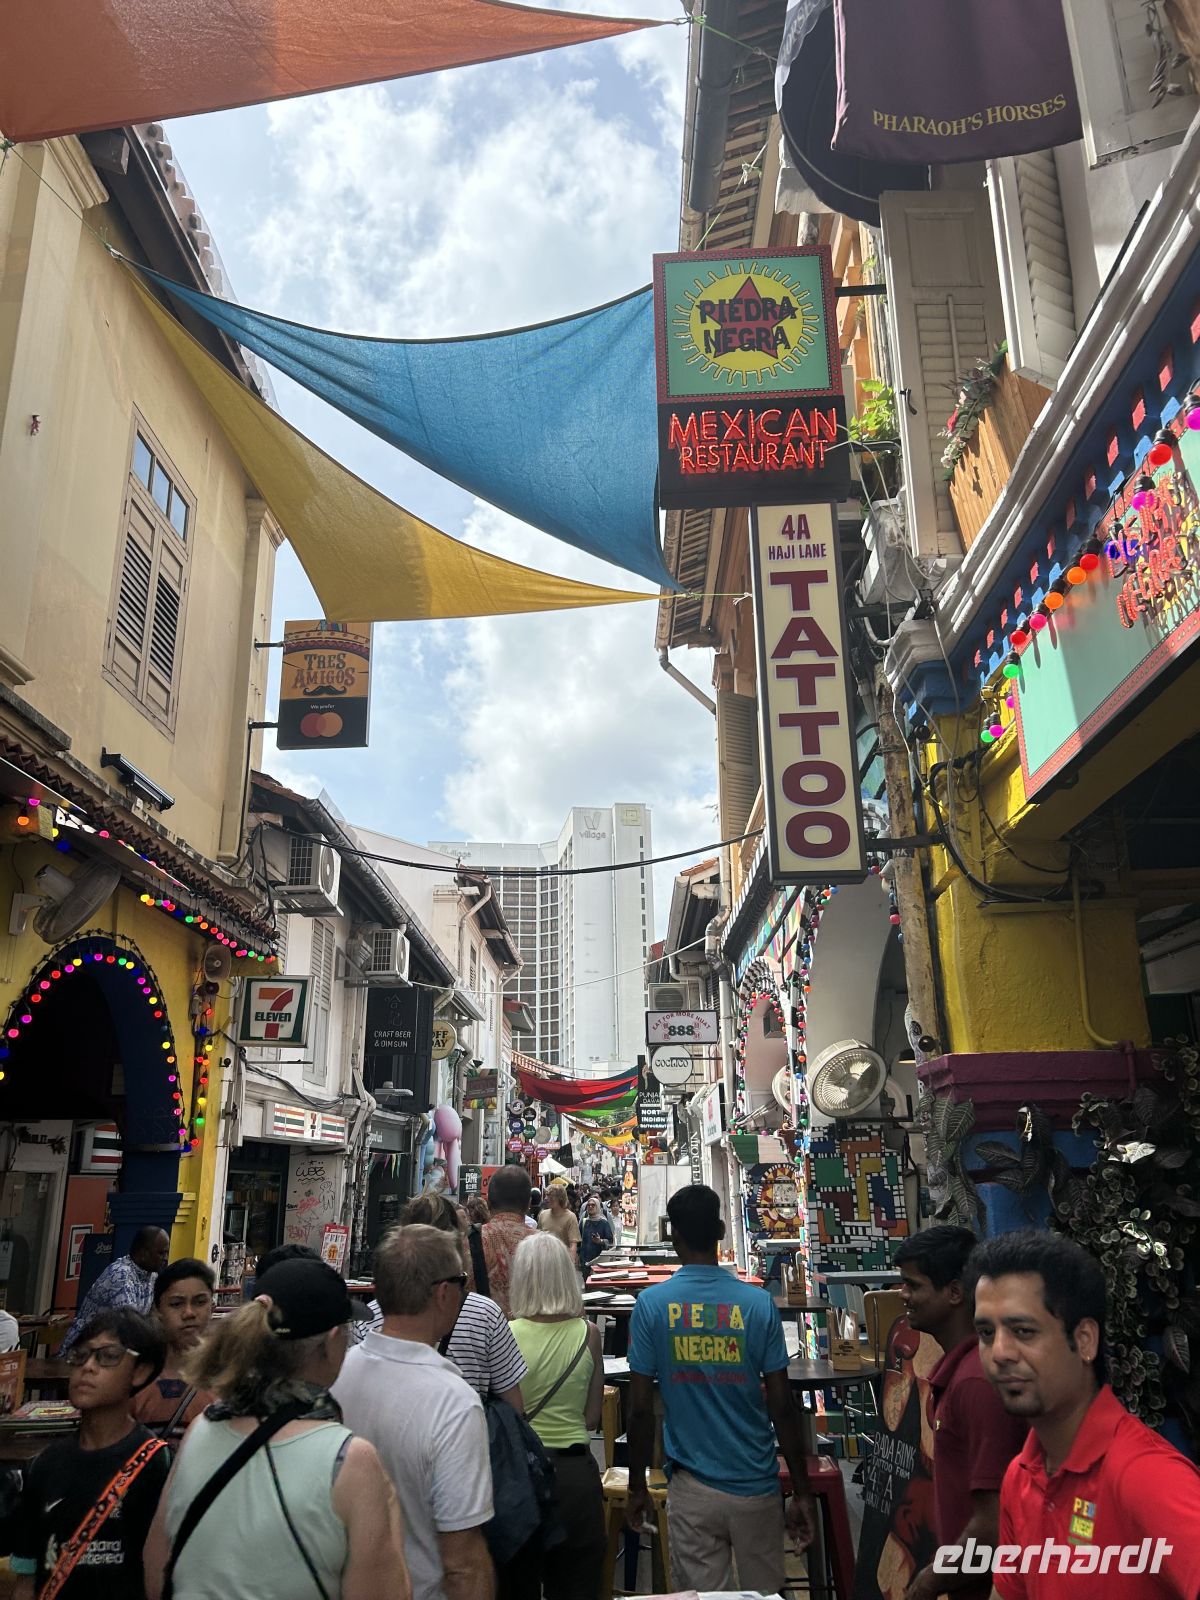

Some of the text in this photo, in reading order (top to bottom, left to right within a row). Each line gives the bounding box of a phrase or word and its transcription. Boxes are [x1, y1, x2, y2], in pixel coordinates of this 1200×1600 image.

[873, 94, 1067, 136] PHARAOH'S HORSES
[699, 296, 797, 324] PIEDRA
[703, 326, 791, 354] NEGRA
[668, 407, 837, 447] MEXICAN
[680, 439, 829, 471] RESTAURANT
[781, 513, 811, 541] 4A
[768, 543, 827, 560] HAJI LANE
[304, 653, 346, 670] TRES
[291, 667, 355, 689] AMIGOS
[770, 569, 851, 859] TATTOO
[579, 831, 606, 841] village
[662, 1013, 675, 1023] FOR
[668, 1025, 695, 1036] 888
[374, 1030, 411, 1038] CRAFT BEER
[374, 1039, 380, 1047] &
[667, 1303, 744, 1329] PIEDRA
[674, 1335, 741, 1362] NEGRA
